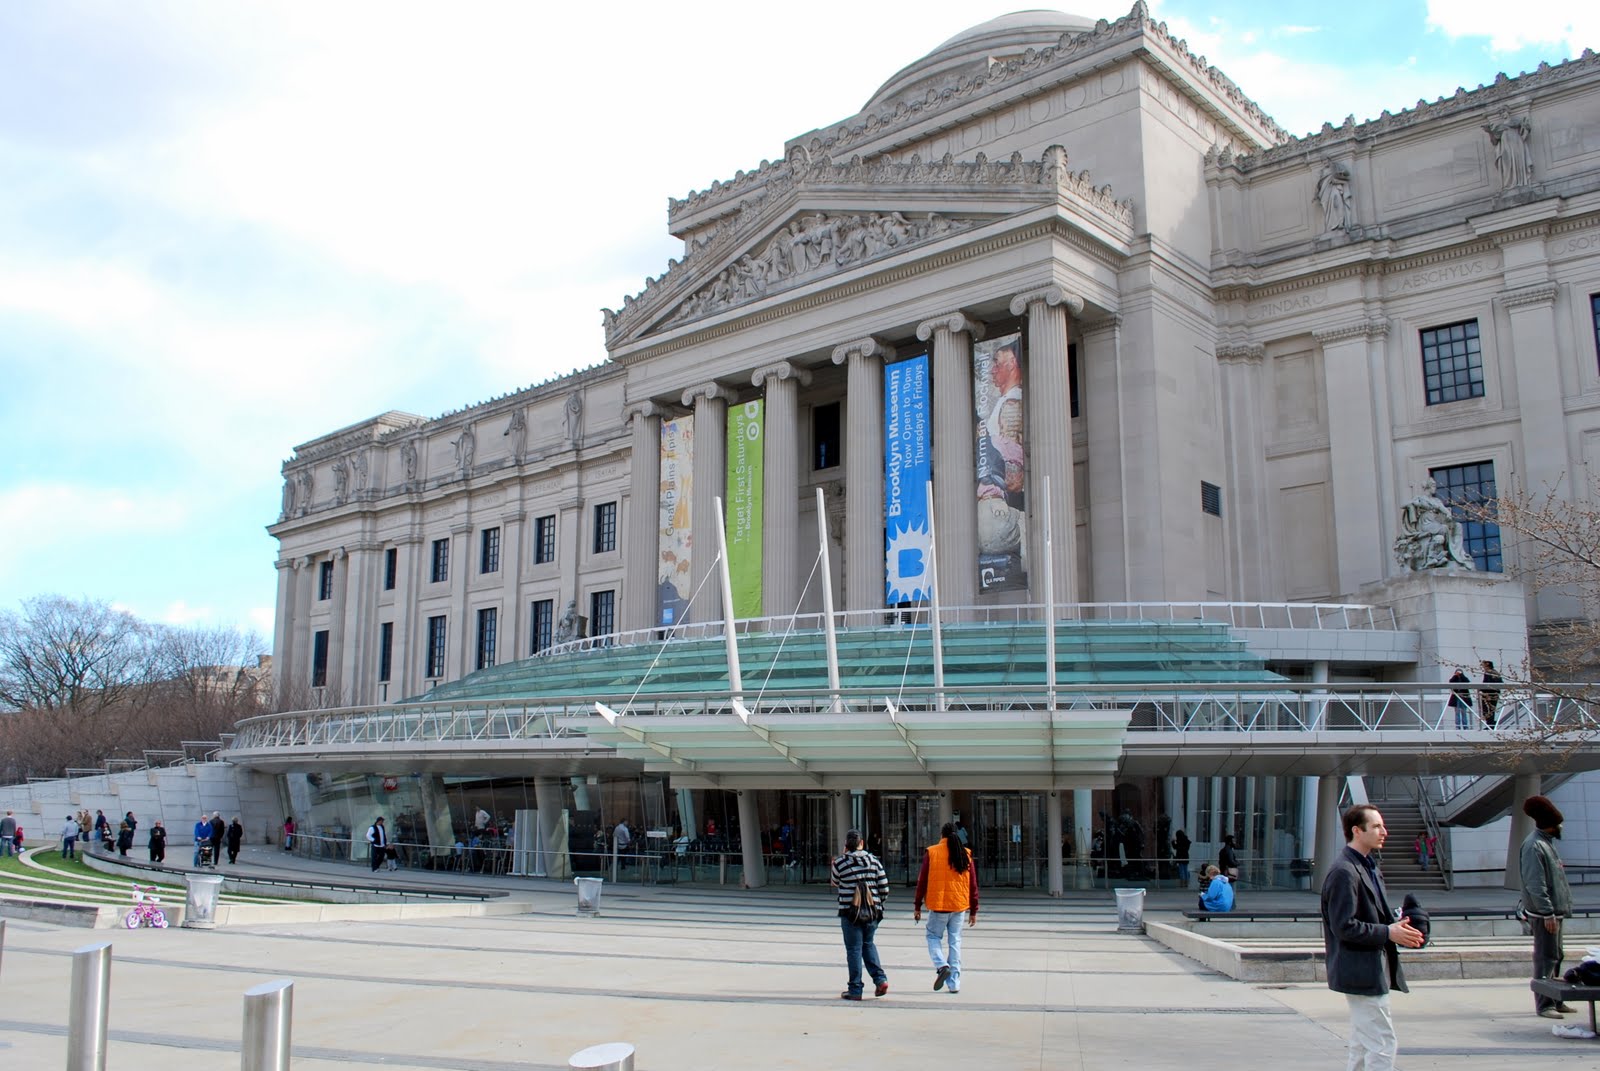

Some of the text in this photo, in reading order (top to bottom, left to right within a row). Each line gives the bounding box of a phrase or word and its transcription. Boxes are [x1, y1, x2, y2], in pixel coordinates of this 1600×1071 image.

[1401, 260, 1483, 290] AESCHYLVS
[1568, 233, 1600, 252] SOP
[1262, 295, 1312, 317] PINDAR
[888, 370, 902, 517] Brooklyn Museum
[902, 367, 913, 469] Now Open to 10pm
[913, 364, 925, 466] Thursdays & Fridays
[977, 352, 990, 478] Norman Rockwell
[665, 431, 676, 537] Great Plains Tipis
[734, 415, 747, 544] Target First Saturdays
